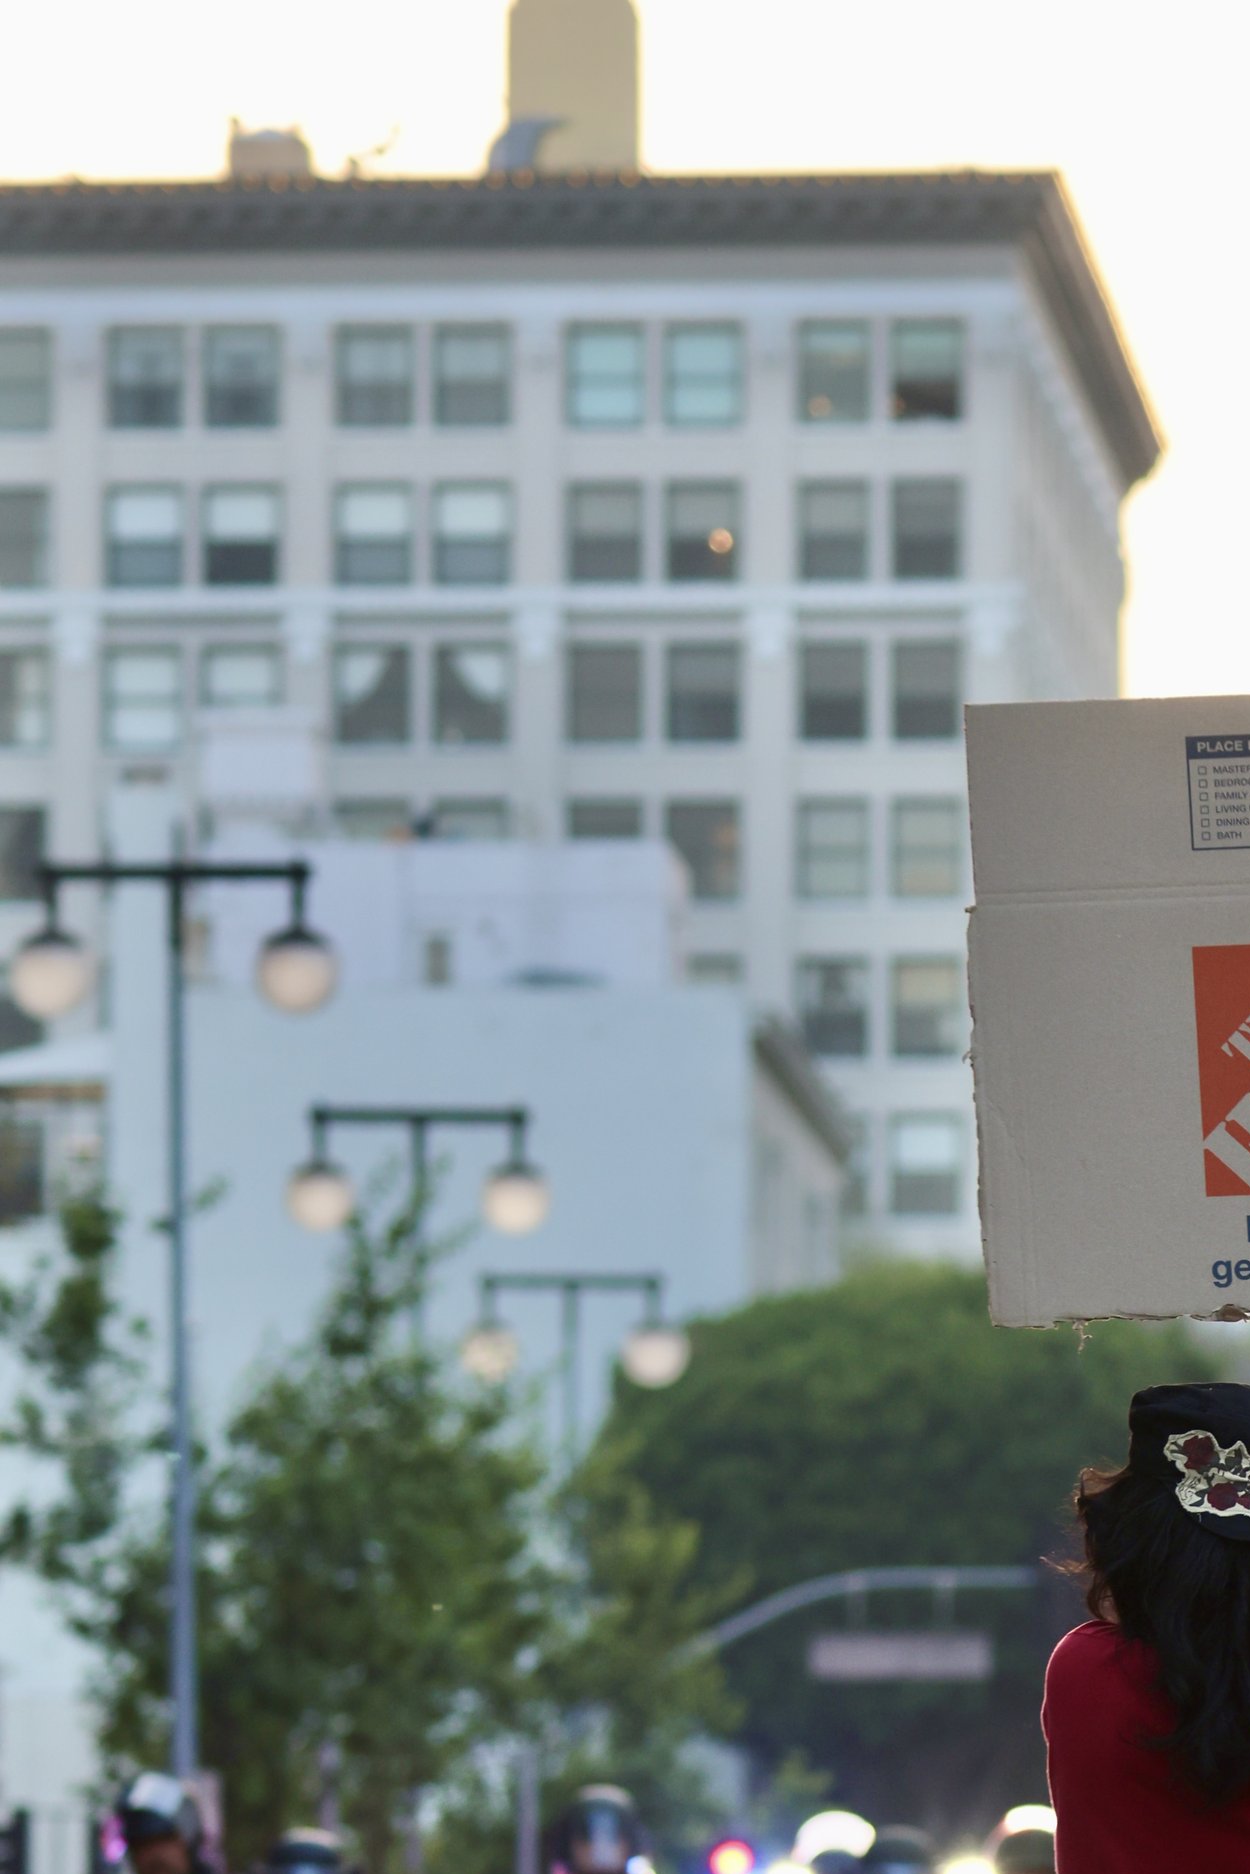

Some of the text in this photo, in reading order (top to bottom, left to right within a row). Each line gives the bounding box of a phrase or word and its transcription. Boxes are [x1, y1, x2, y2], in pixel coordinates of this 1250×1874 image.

[1196, 740, 1243, 753] PLACE
[1215, 791, 1248, 800] FAMILY
[1215, 804, 1247, 814] LIVING
[1216, 817, 1250, 827] DINING
[1217, 830, 1242, 840] BATH
